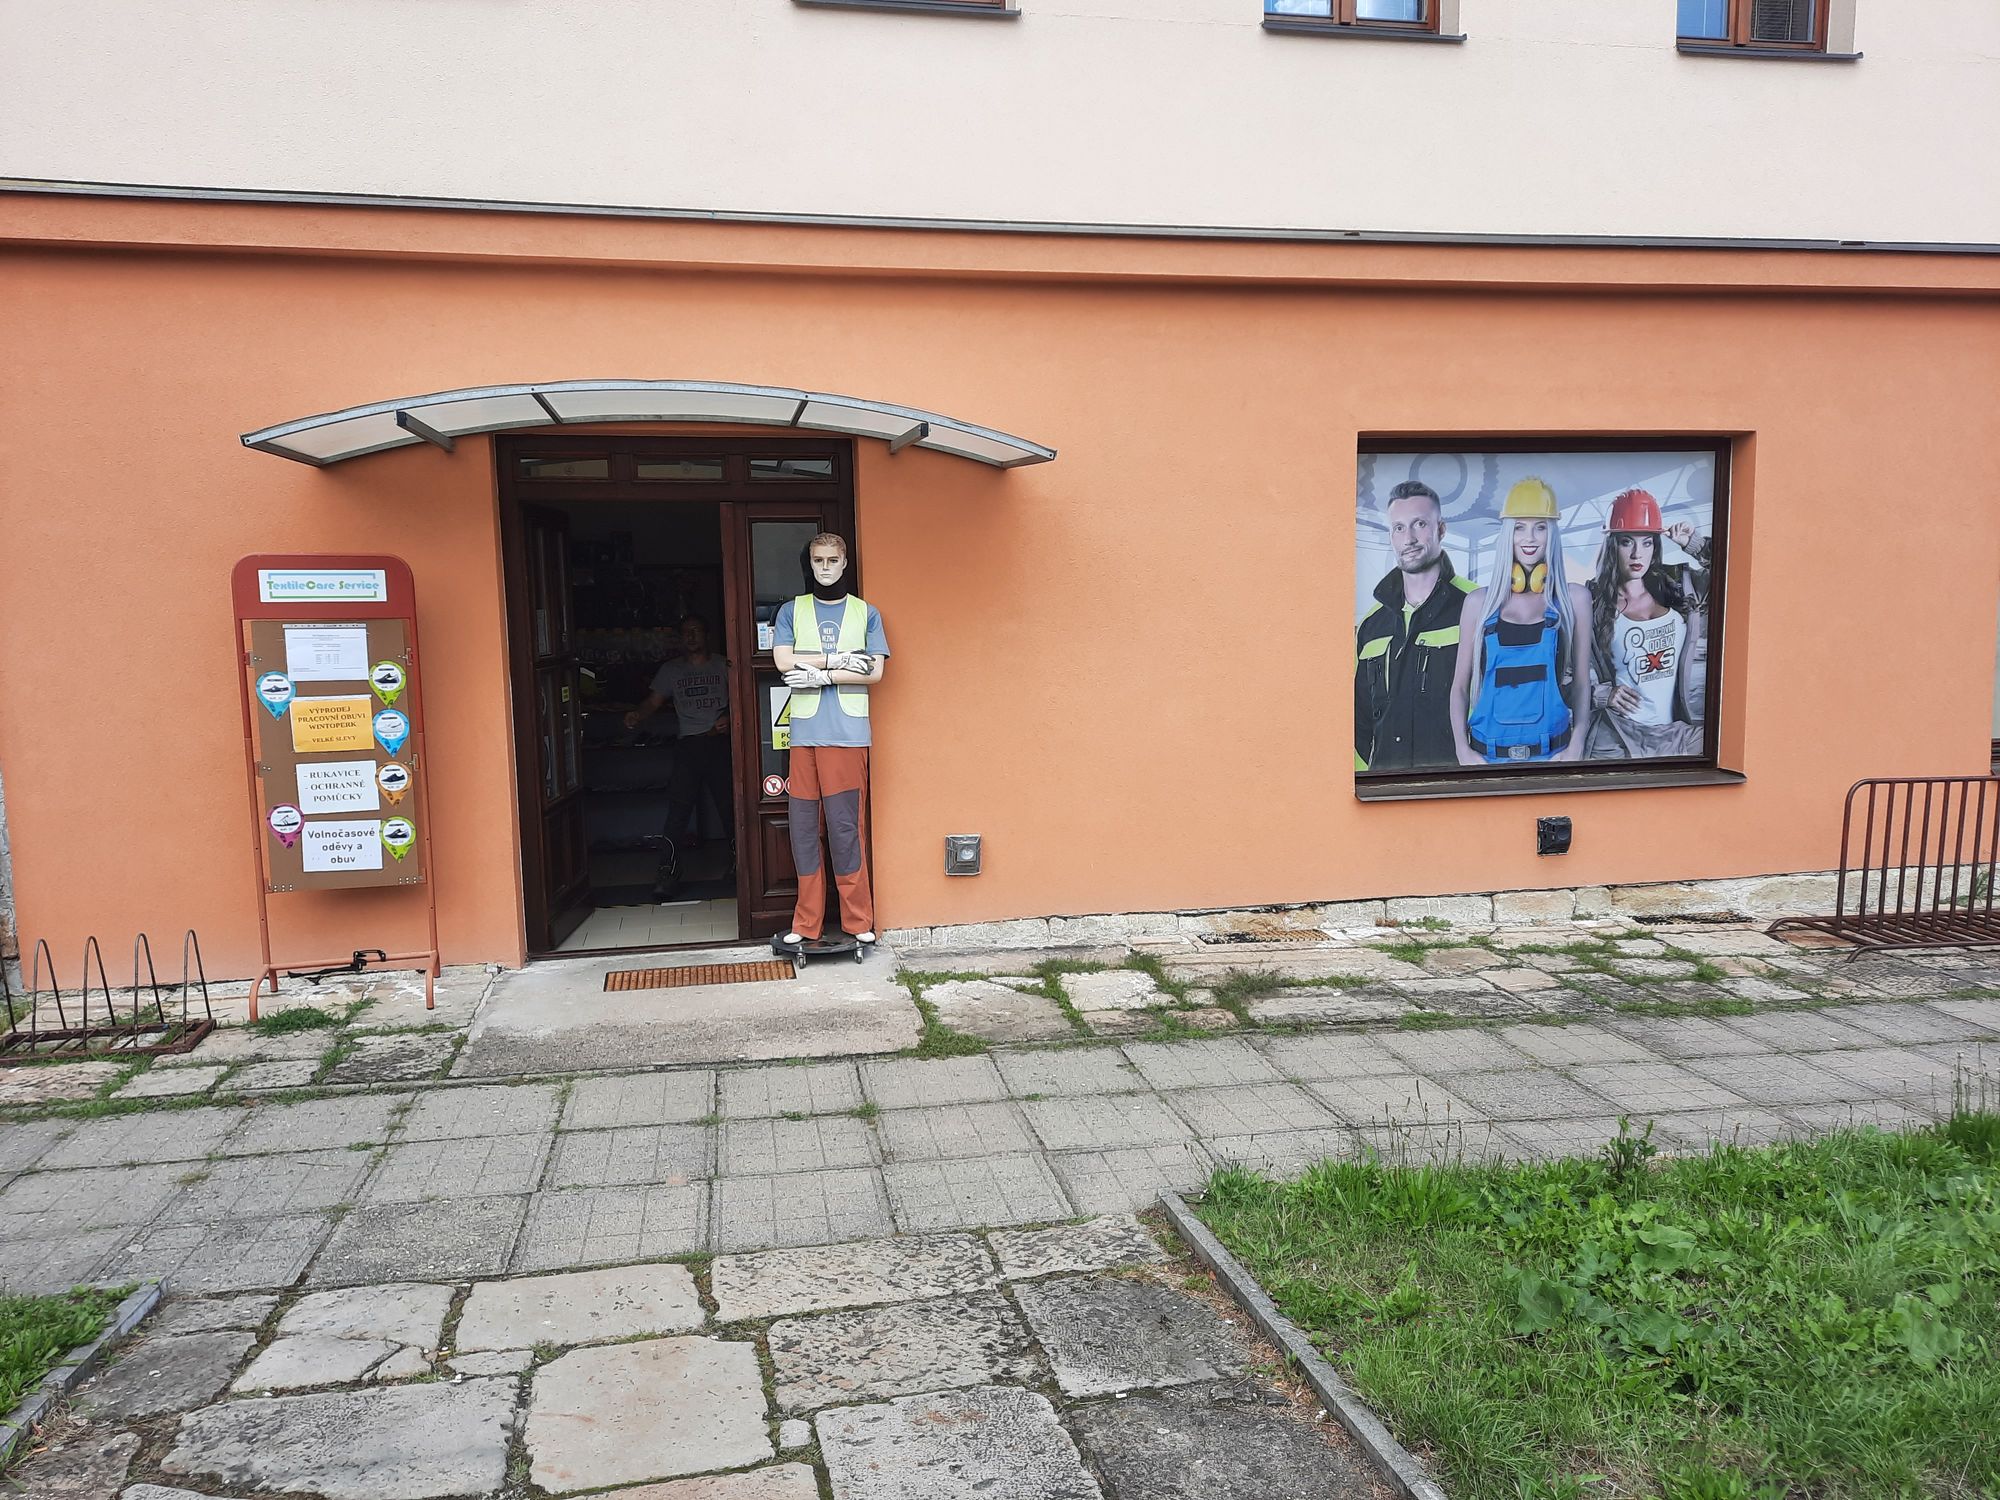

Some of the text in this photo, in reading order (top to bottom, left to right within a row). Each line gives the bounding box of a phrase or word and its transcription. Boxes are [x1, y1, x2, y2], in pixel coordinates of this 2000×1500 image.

[266, 580, 380, 590] TextileCare Service
[1635, 647, 1676, 675] CXS
[677, 675, 721, 689] SUPERIOR
[298, 713, 366, 723] PRACOVNÍ OBUVI
[308, 721, 357, 730] WINTOPERK
[309, 769, 361, 779] RUKAVICE
[310, 780, 366, 791] OCHRANNÉ
[307, 827, 375, 839] Volnočasové
[322, 842, 353, 852] oděvy
[330, 855, 356, 864] obuv
